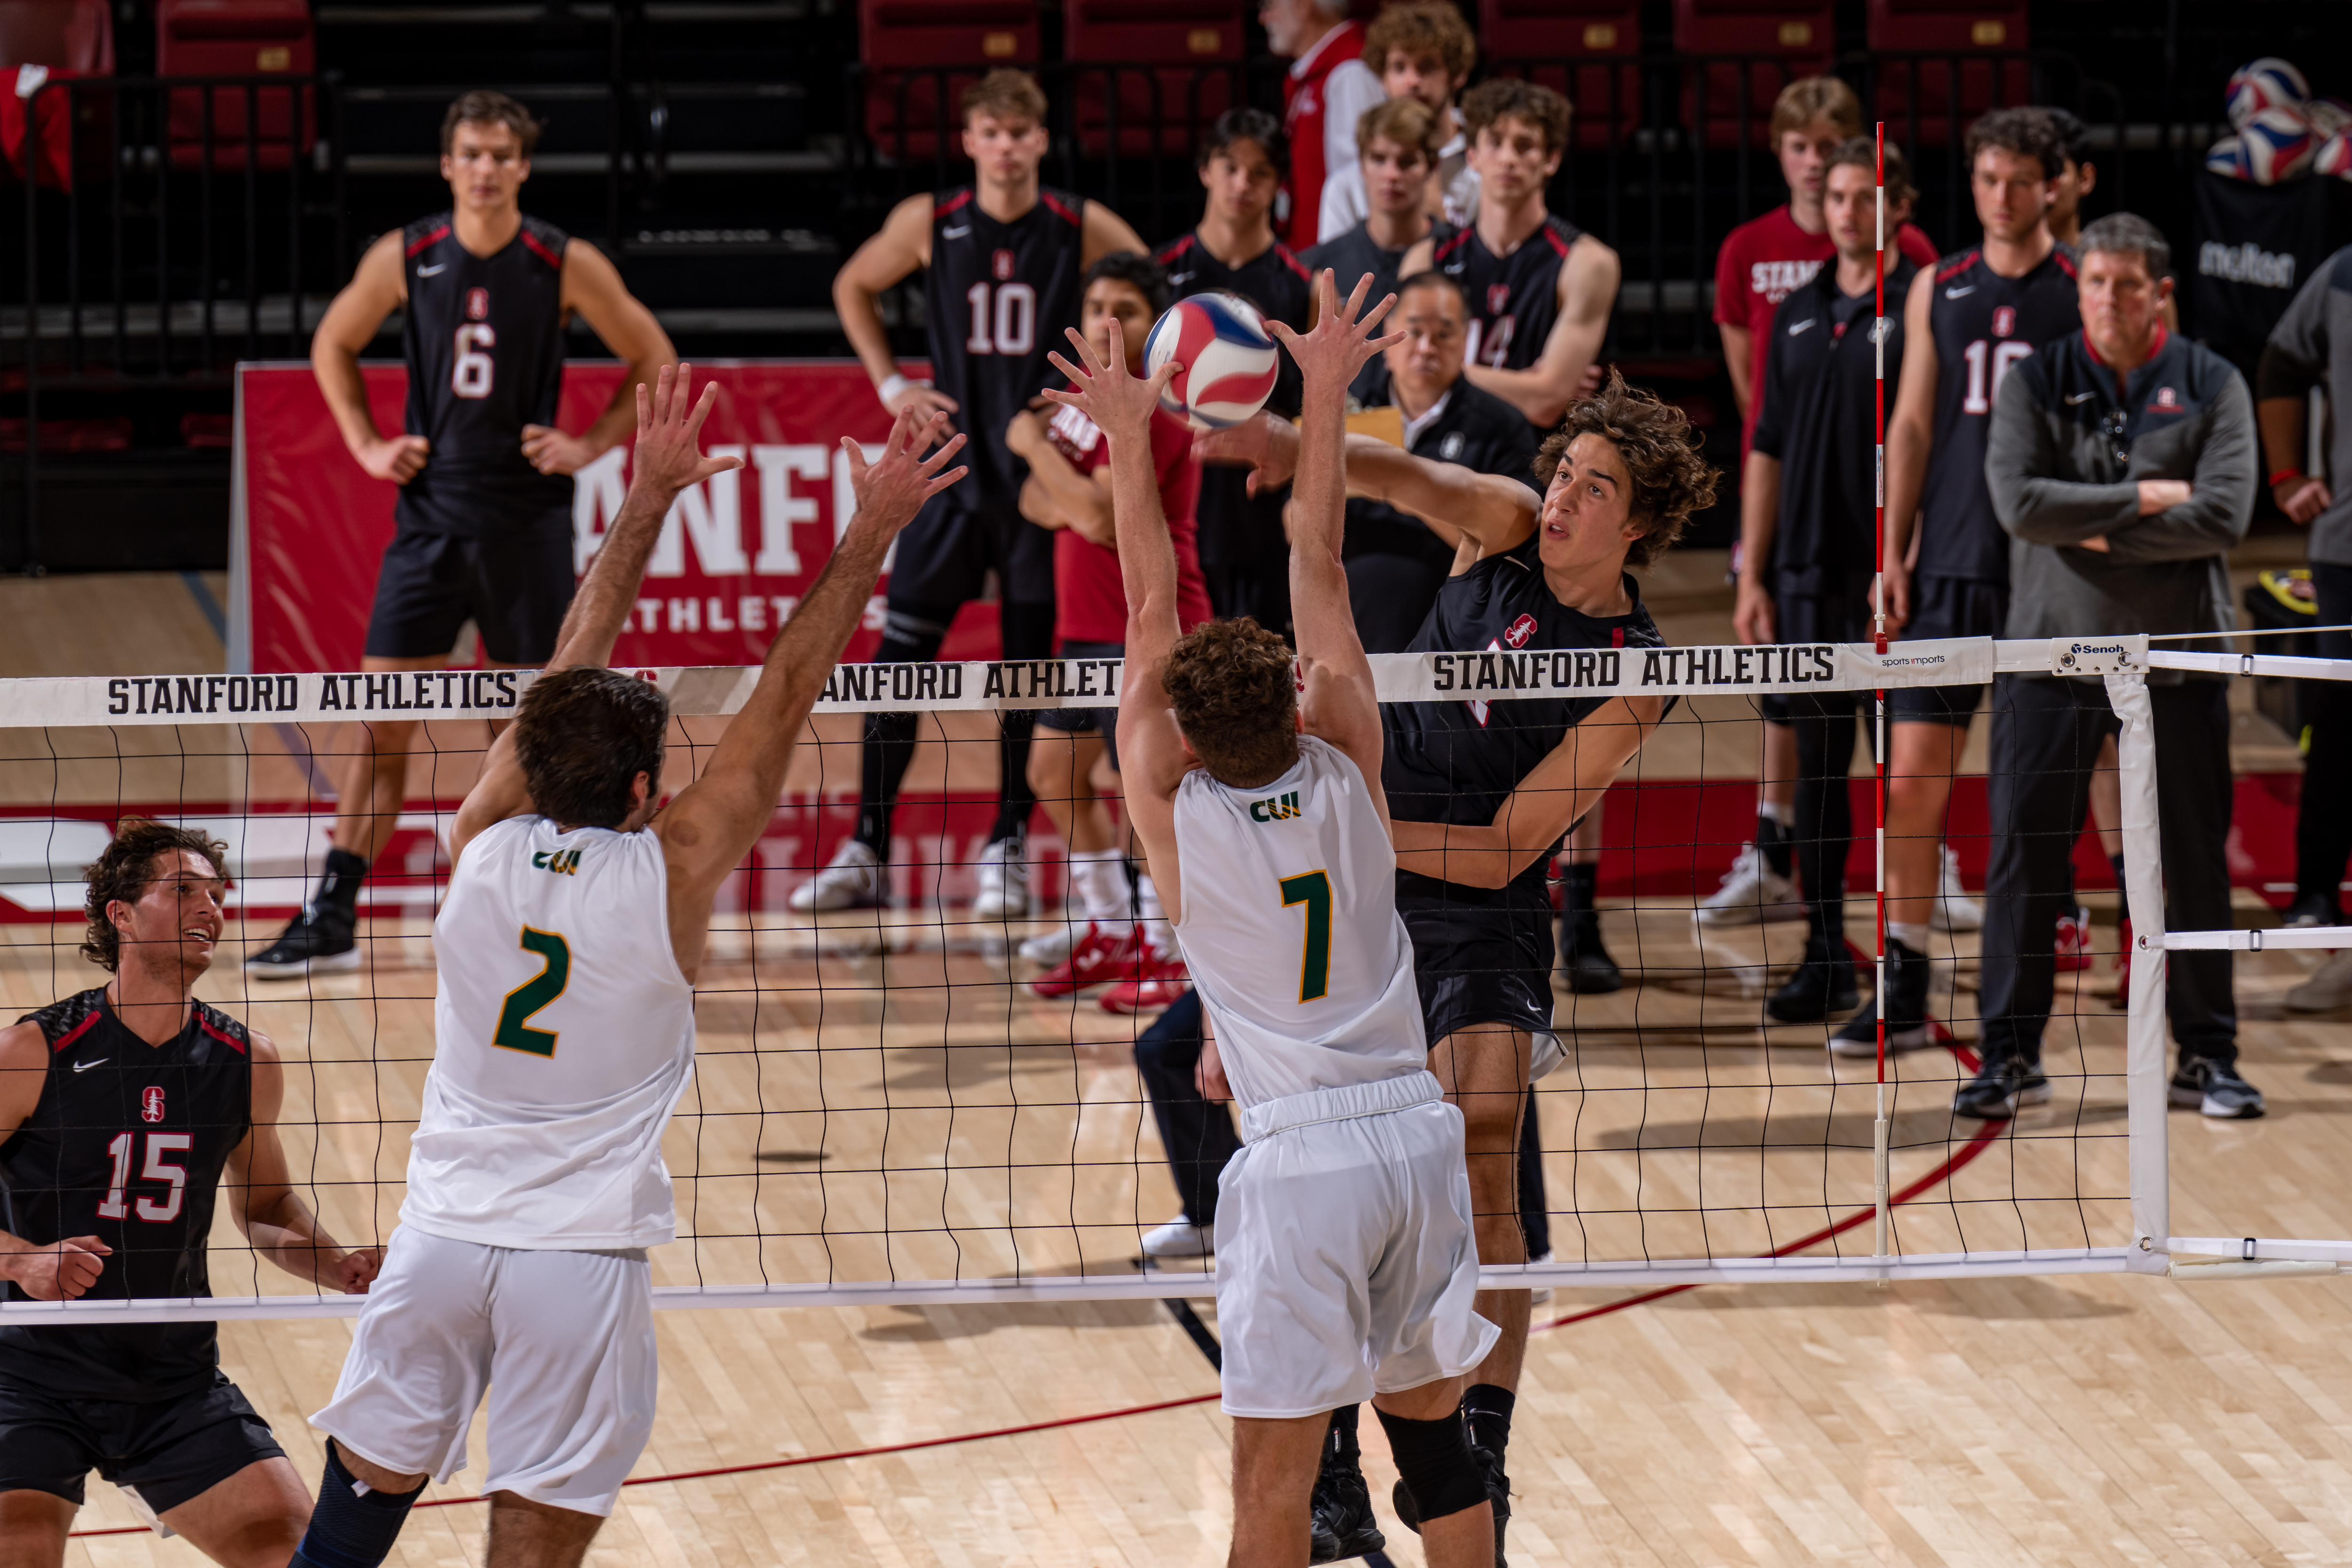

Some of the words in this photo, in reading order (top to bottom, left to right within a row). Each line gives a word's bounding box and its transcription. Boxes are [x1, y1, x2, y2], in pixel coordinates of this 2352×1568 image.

[966, 281, 1037, 356] 10
[1464, 314, 1516, 370] 14
[451, 322, 496, 399] 6
[1434, 651, 1620, 691] STANFORD
[1641, 646, 1834, 686] ATHLETICS
[1882, 658, 1910, 668] sports
[2082, 645, 2124, 653] Senoh
[108, 675, 298, 714] STANFORD
[319, 672, 516, 710] ATHLETICS
[983, 660, 1125, 699] ATHLET
[1249, 790, 1302, 822] CUI
[1278, 868, 1333, 1004] 7
[491, 923, 572, 1060] 2
[95, 1131, 194, 1223] 15
